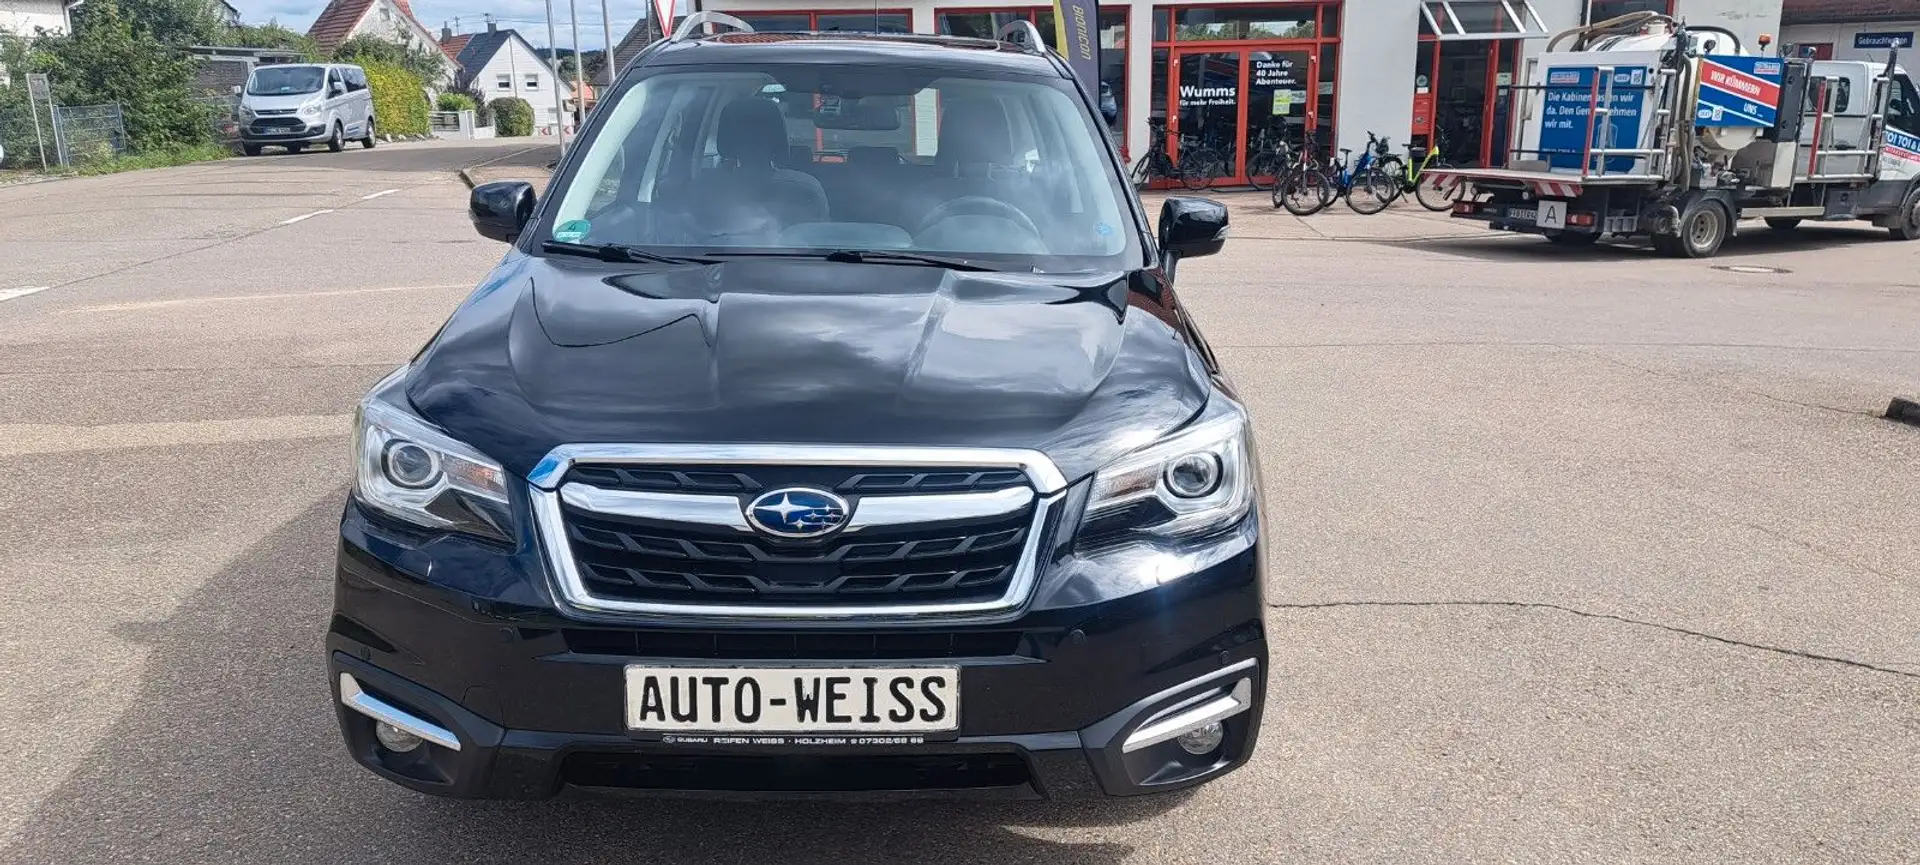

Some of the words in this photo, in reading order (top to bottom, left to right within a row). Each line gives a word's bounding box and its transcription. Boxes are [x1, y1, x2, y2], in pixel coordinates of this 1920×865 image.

[1256, 61, 1281, 69] Danke
[1282, 60, 1293, 69] für
[1256, 69, 1266, 77] 40
[1267, 69, 1289, 77] Jahre
[1256, 77, 1297, 86] Abenteuer.
[1180, 85, 1236, 98] Wumms
[1548, 92, 1561, 101] Die
[1620, 92, 1634, 101] wir
[1546, 106, 1558, 116] da.
[1559, 106, 1575, 115] Den
[1897, 135, 1912, 149] TOI
[1544, 205, 1557, 224] A
[568, 221, 577, 231] 4
[639, 675, 946, 723] AUTO-WEISS
[713, 737, 750, 745] REIFEN
[752, 737, 785, 745] WEISS
[794, 737, 846, 745] HOLZHEIM
